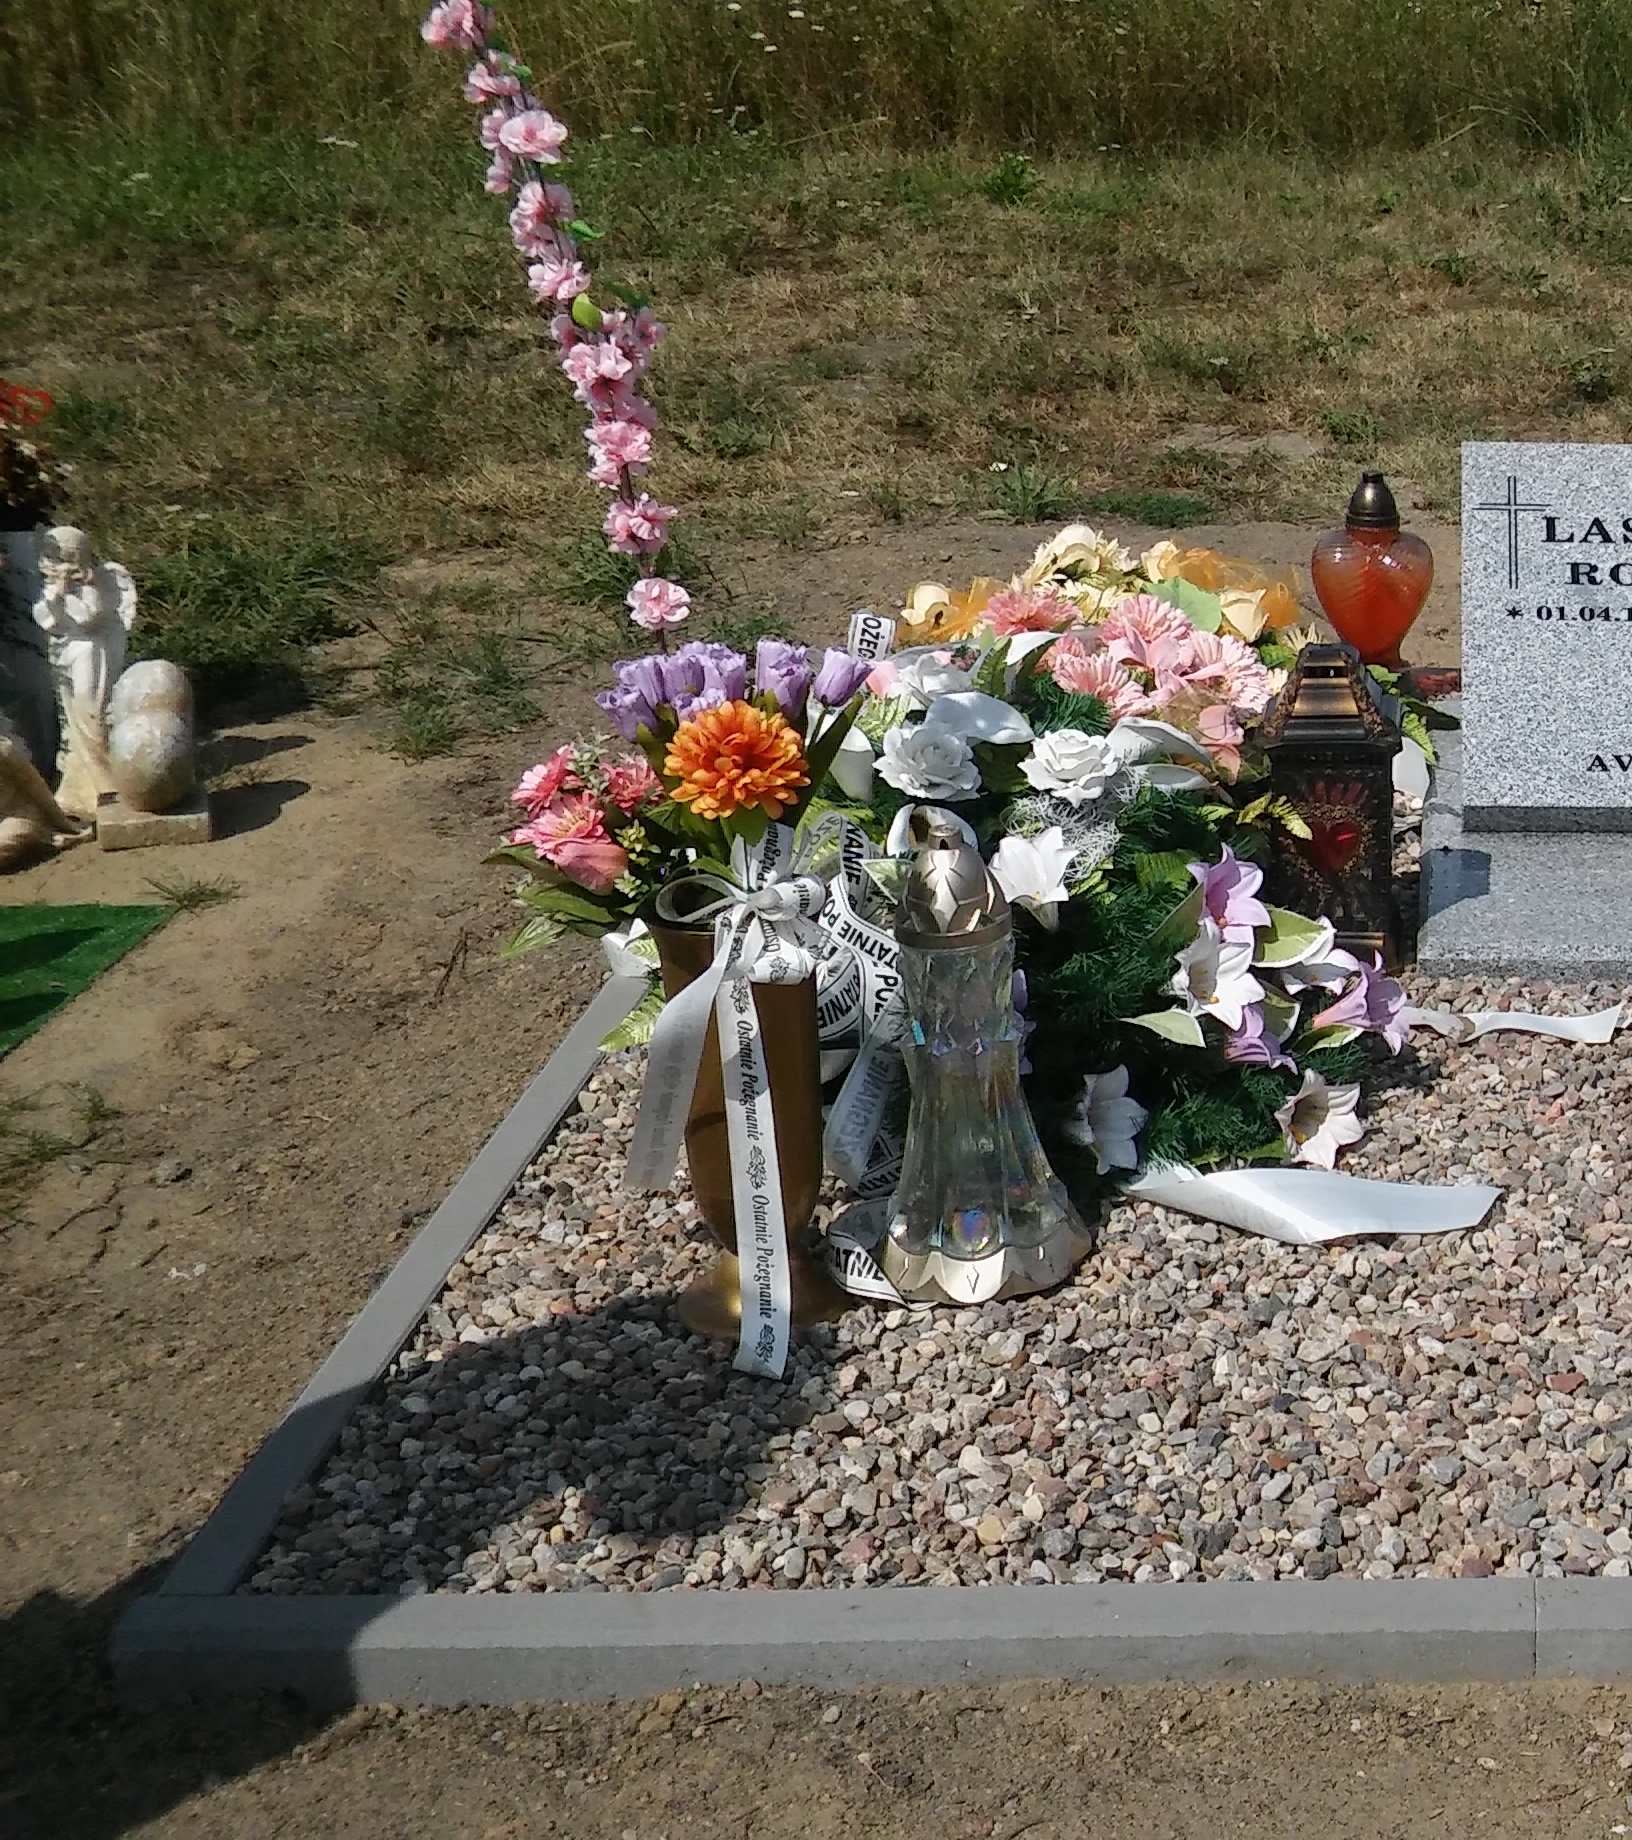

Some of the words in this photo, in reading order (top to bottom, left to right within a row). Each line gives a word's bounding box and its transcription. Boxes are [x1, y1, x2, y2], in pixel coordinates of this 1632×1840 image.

[736, 1020, 757, 1071] Ostatnie
[739, 1072, 764, 1141] Pożegnanie
[751, 1194, 773, 1245] Ostatnie
[753, 1246, 778, 1320] Pożegnanie
